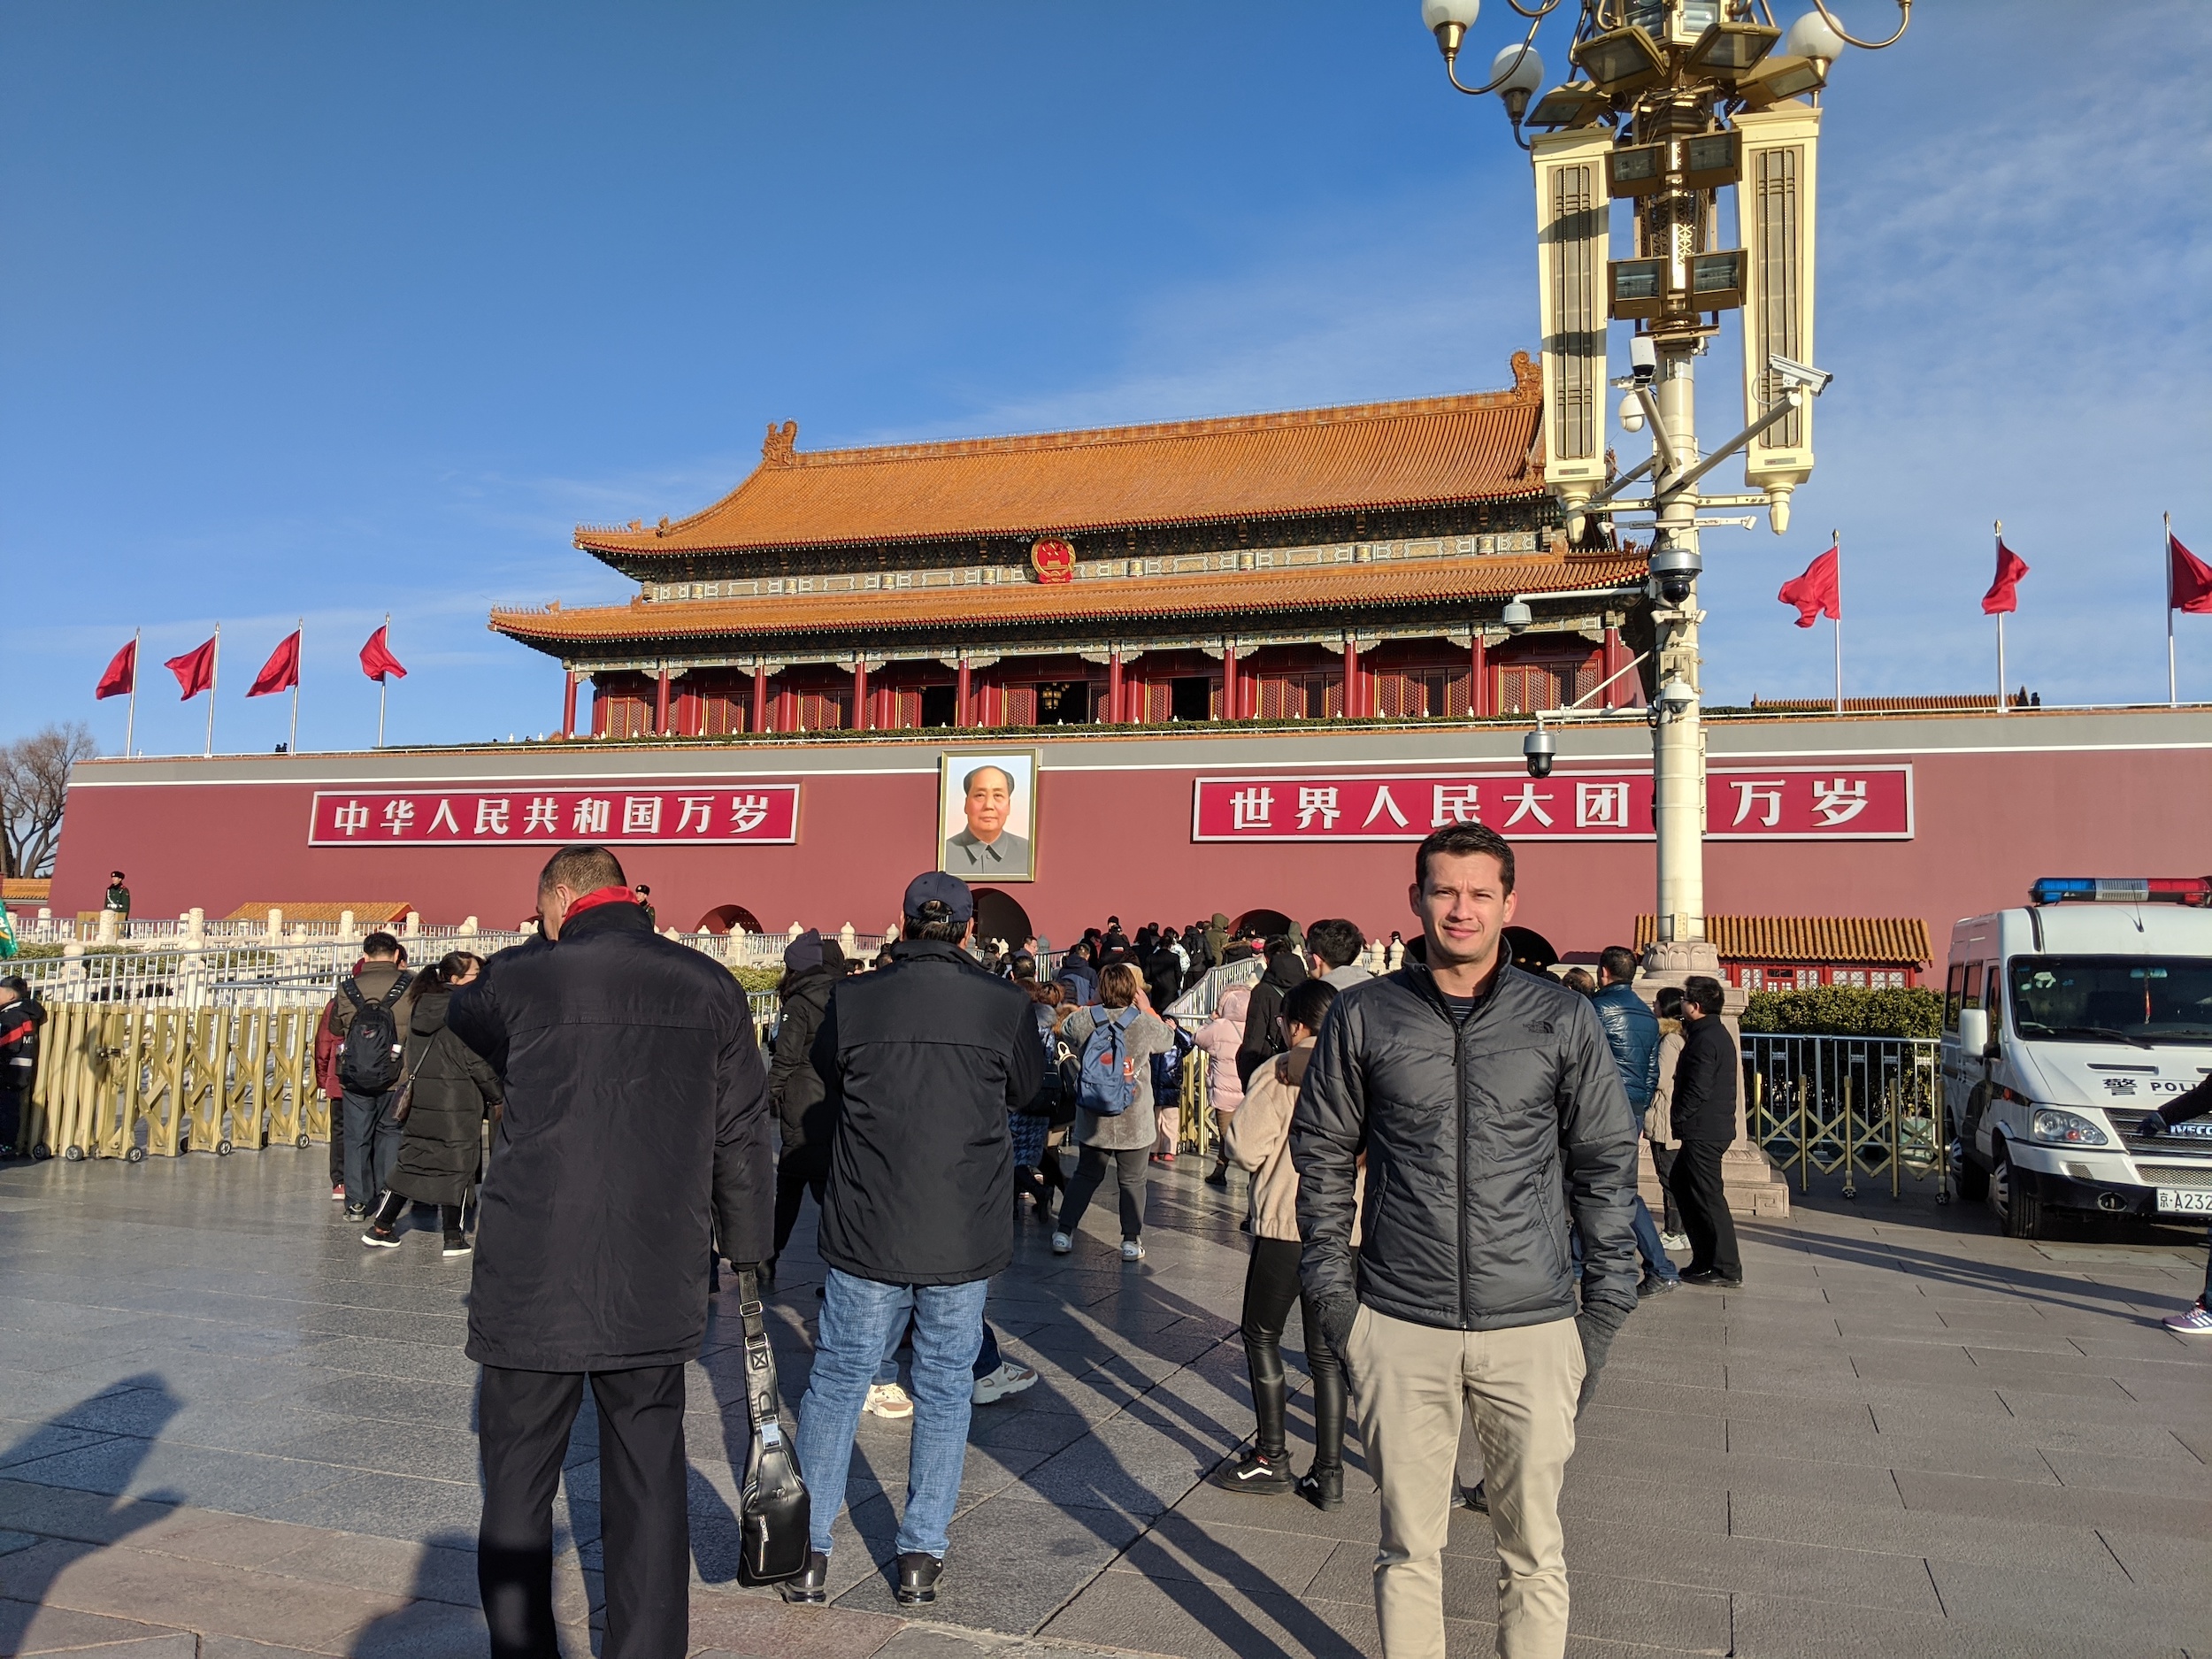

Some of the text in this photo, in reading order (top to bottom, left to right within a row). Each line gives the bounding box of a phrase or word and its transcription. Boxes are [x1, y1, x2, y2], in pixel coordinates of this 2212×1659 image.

[334, 795, 769, 836] 中华人民共和国万岁
[1229, 778, 1869, 830] 世界人民大团万岁
[2102, 1078, 2138, 1096] 警
